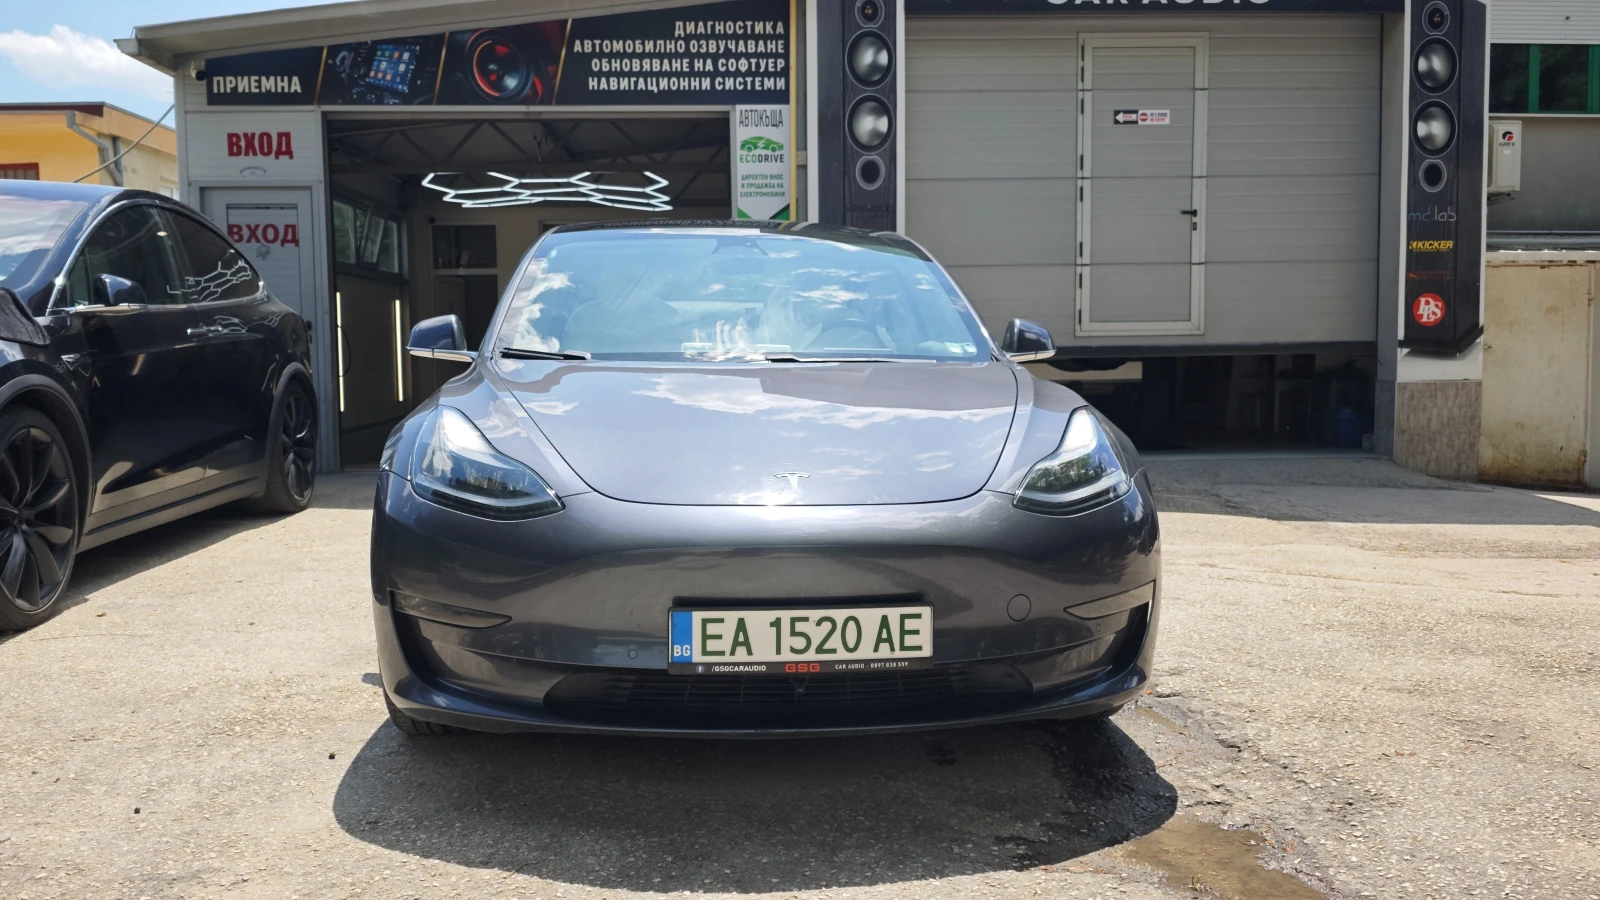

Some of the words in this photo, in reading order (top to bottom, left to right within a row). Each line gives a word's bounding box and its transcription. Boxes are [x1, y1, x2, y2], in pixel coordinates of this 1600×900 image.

[674, 21, 785, 37] ДИАГНОСТИКА
[573, 39, 686, 53] АВТОМОБИЛНО
[689, 39, 785, 53] ОЗВУЧАВАНЕ
[591, 58, 690, 72] ОБНОВЯВАНЕ
[694, 58, 714, 72] НА
[718, 57, 785, 73] СОФТУЕР
[212, 75, 302, 93] ПРИЕМНА
[588, 77, 711, 93] НАВИГАЦИОННИ
[715, 77, 786, 91] СИСТЕМИ
[739, 109, 784, 129] АВТОКЪЩА
[227, 132, 294, 160] ВХОД
[740, 154, 785, 163] ECODRIVE
[228, 223, 300, 247] ВХОД
[1417, 241, 1454, 250] KICKER
[700, 617, 754, 657] EA
[769, 615, 863, 655] 1520
[872, 612, 923, 653] AE
[673, 645, 691, 657] BG
[785, 663, 820, 673] GSG
